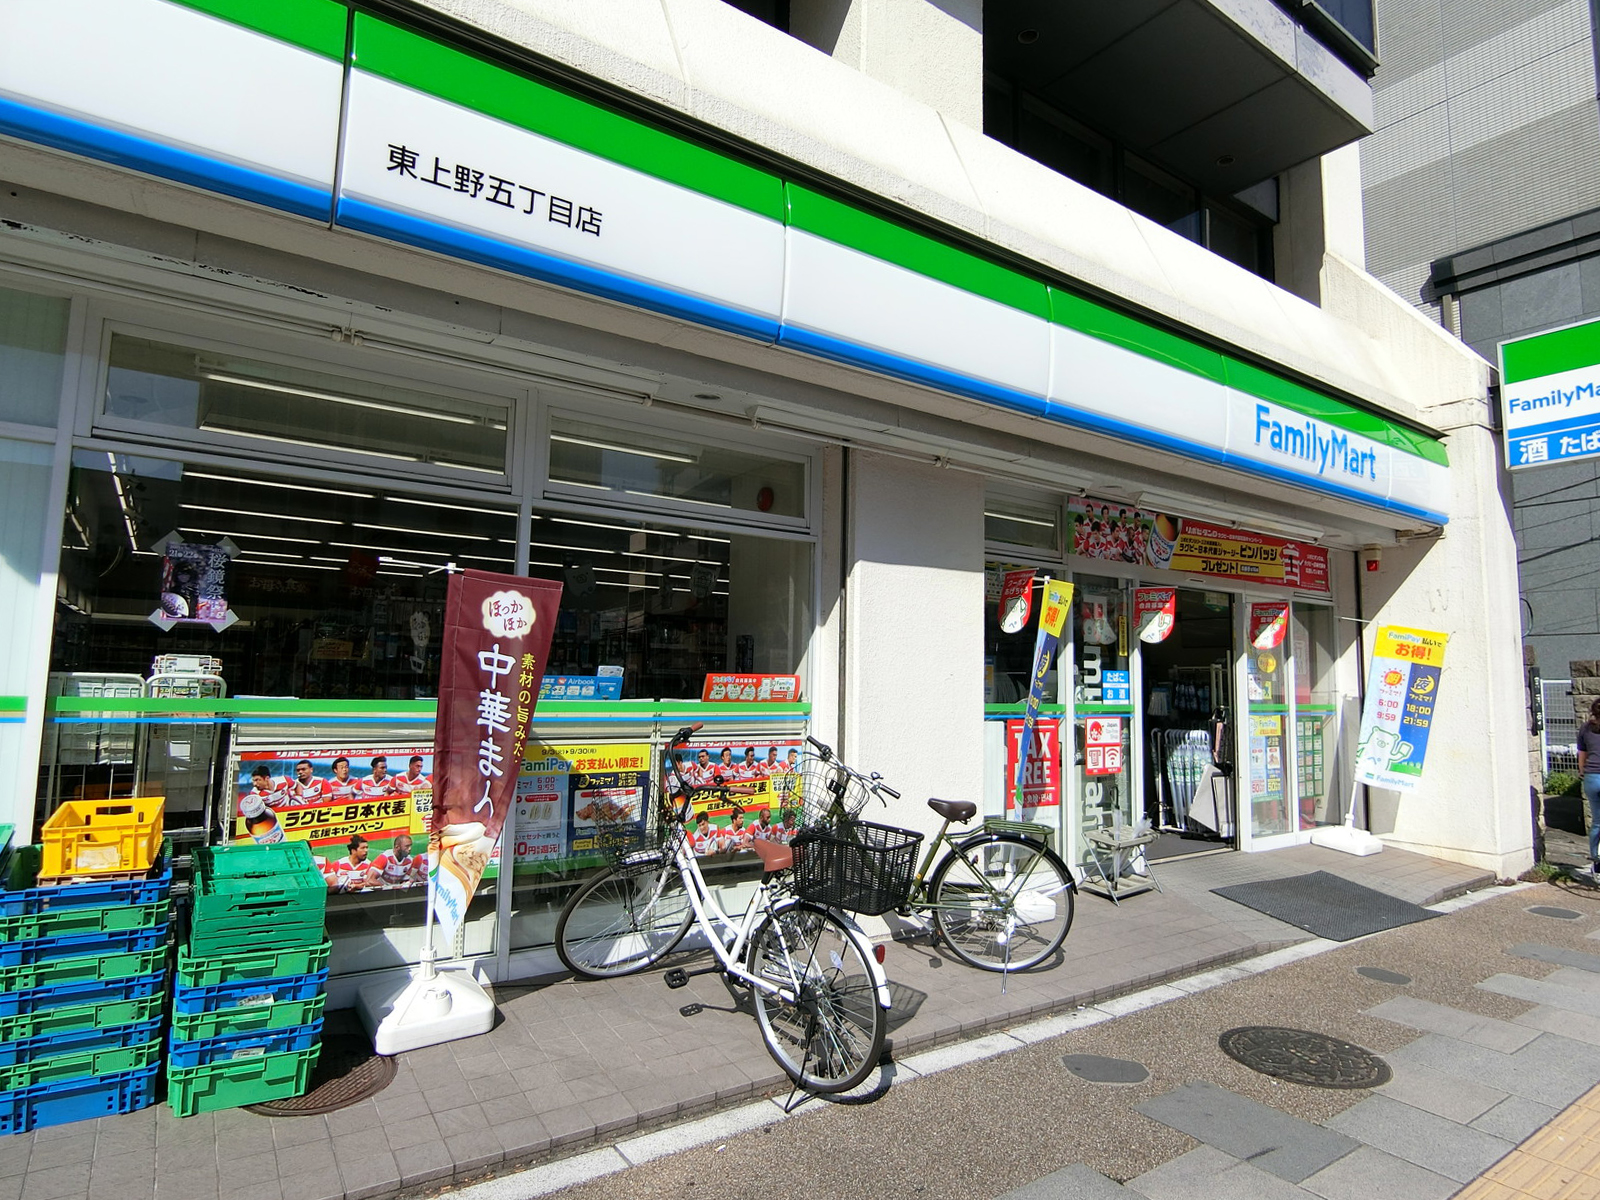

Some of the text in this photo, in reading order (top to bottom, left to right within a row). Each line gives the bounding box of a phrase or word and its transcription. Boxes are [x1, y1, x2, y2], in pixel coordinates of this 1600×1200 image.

[387, 144, 603, 237] 東上野五丁目店
[1255, 403, 1376, 481] FamilyMart
[1519, 437, 1548, 463] 酒
[488, 600, 524, 617] ほっか
[503, 617, 528, 631] ほか
[1395, 642, 1432, 660] お得!
[513, 652, 536, 762] 素材の旨みた
[1378, 699, 1399, 709] 6:00
[1406, 703, 1431, 716] 18:00
[1376, 711, 1397, 722] 9:59
[1403, 716, 1430, 728] 21:59
[575, 756, 644, 771] お支払い限定!
[285, 800, 406, 828] ラグビー日本代表
[309, 821, 384, 839] 応援キャンペーン
